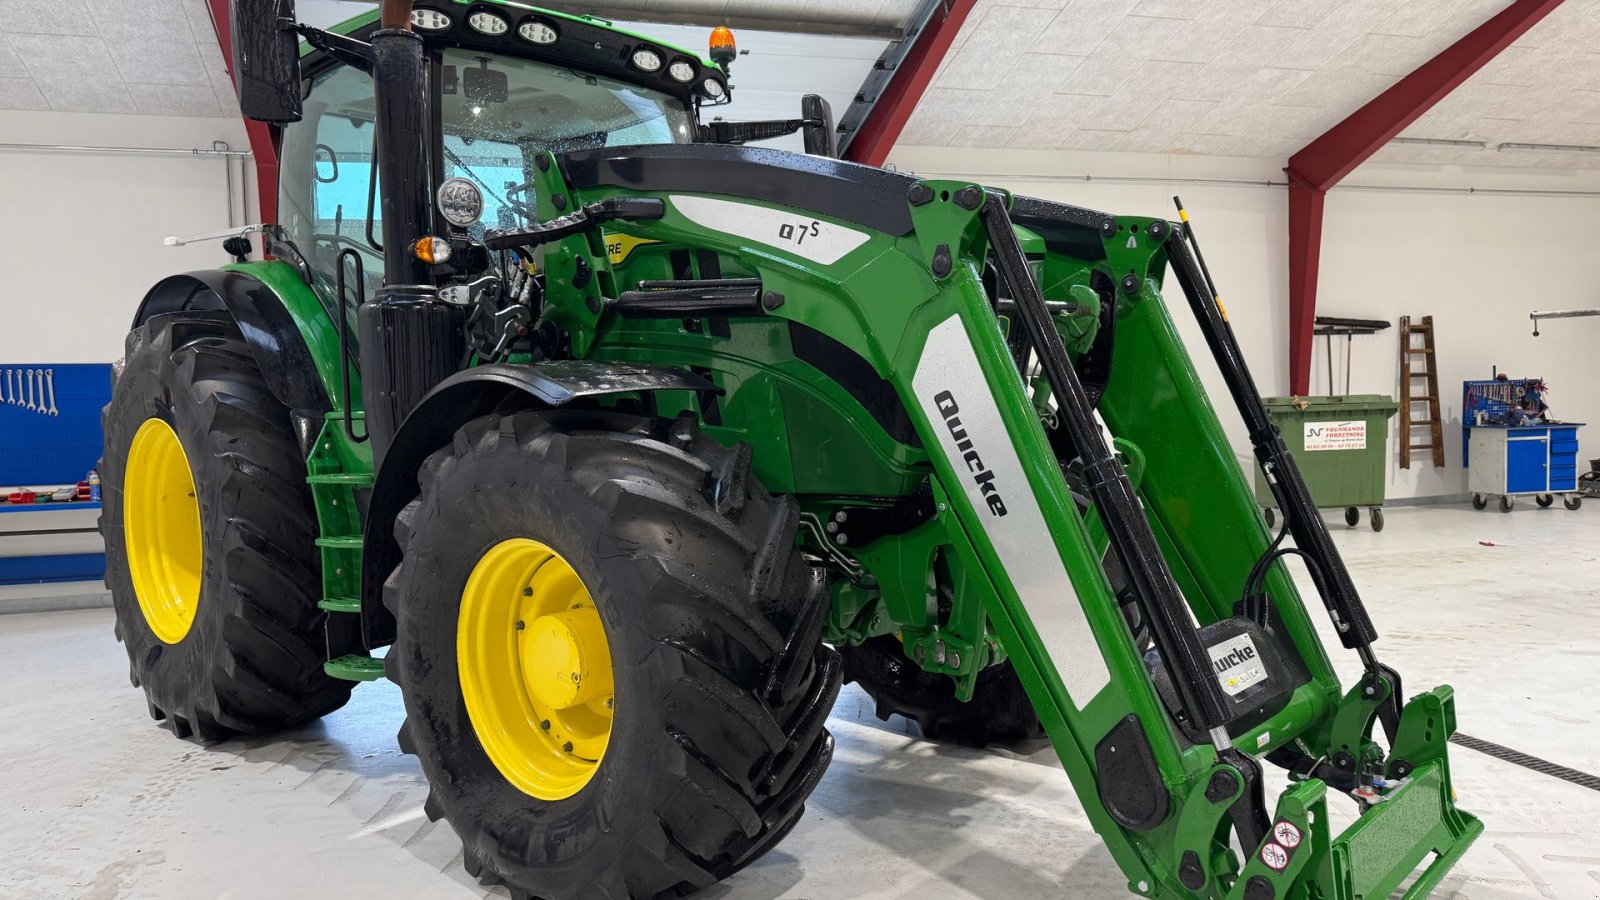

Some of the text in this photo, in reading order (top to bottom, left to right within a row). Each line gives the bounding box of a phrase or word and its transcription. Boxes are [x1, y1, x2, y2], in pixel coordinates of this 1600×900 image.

[606, 243, 621, 255] RE
[934, 390, 1008, 517] Quicke
[1214, 646, 1255, 673] uicke
